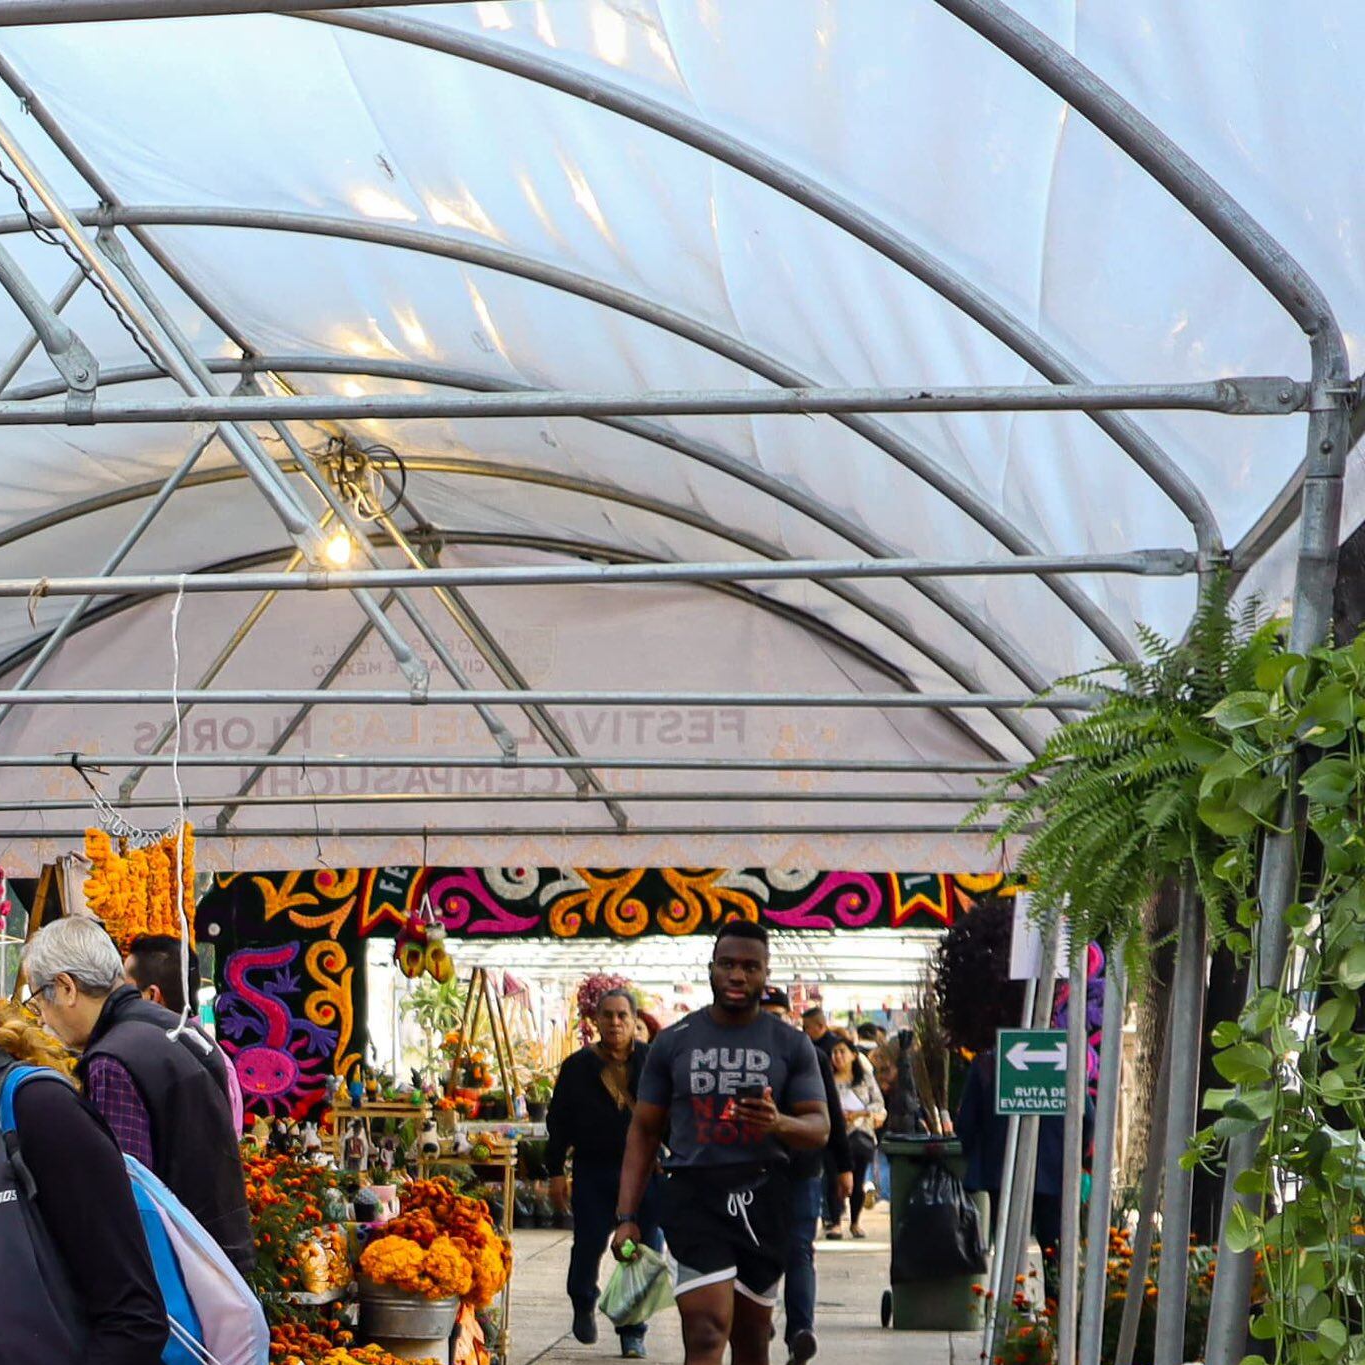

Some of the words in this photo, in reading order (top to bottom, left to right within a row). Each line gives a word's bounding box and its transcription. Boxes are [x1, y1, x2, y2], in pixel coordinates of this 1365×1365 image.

[690, 1048, 771, 1071] MUD
[1014, 1087, 1047, 1098] RUTA
[1051, 1087, 1066, 1098] DE
[1000, 1098, 1067, 1109] EVACUACI
